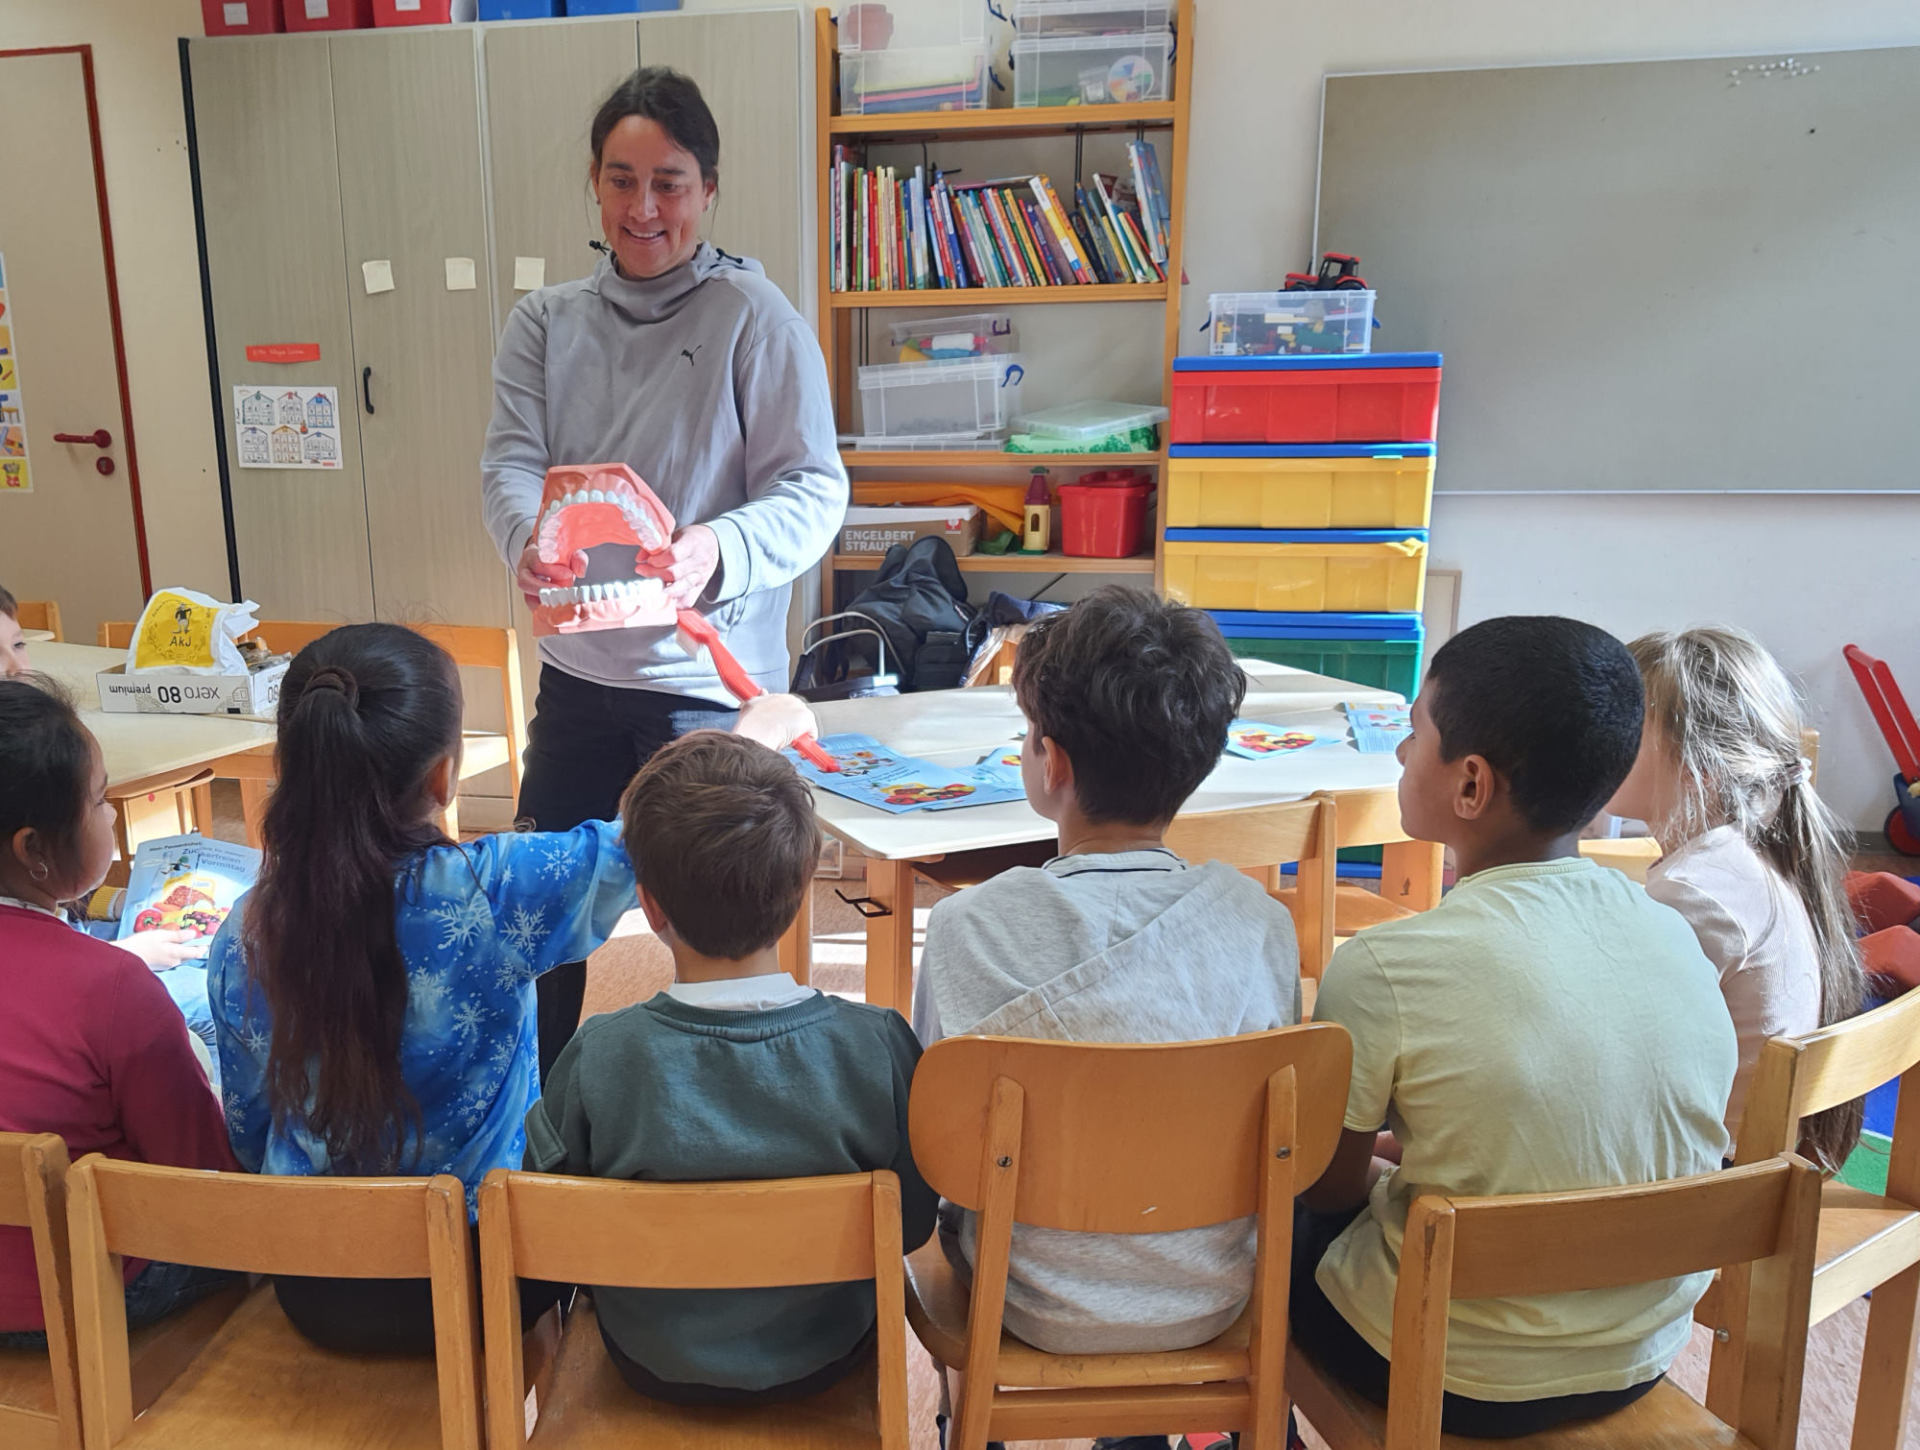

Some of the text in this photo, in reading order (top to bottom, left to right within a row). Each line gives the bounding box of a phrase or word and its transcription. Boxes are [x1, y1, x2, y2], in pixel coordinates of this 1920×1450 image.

[845, 530, 916, 541] ENGELBERT
[845, 541, 899, 551] STRAUS
[169, 636, 192, 648] AkJ
[109, 683, 220, 703] xero 80 premium
